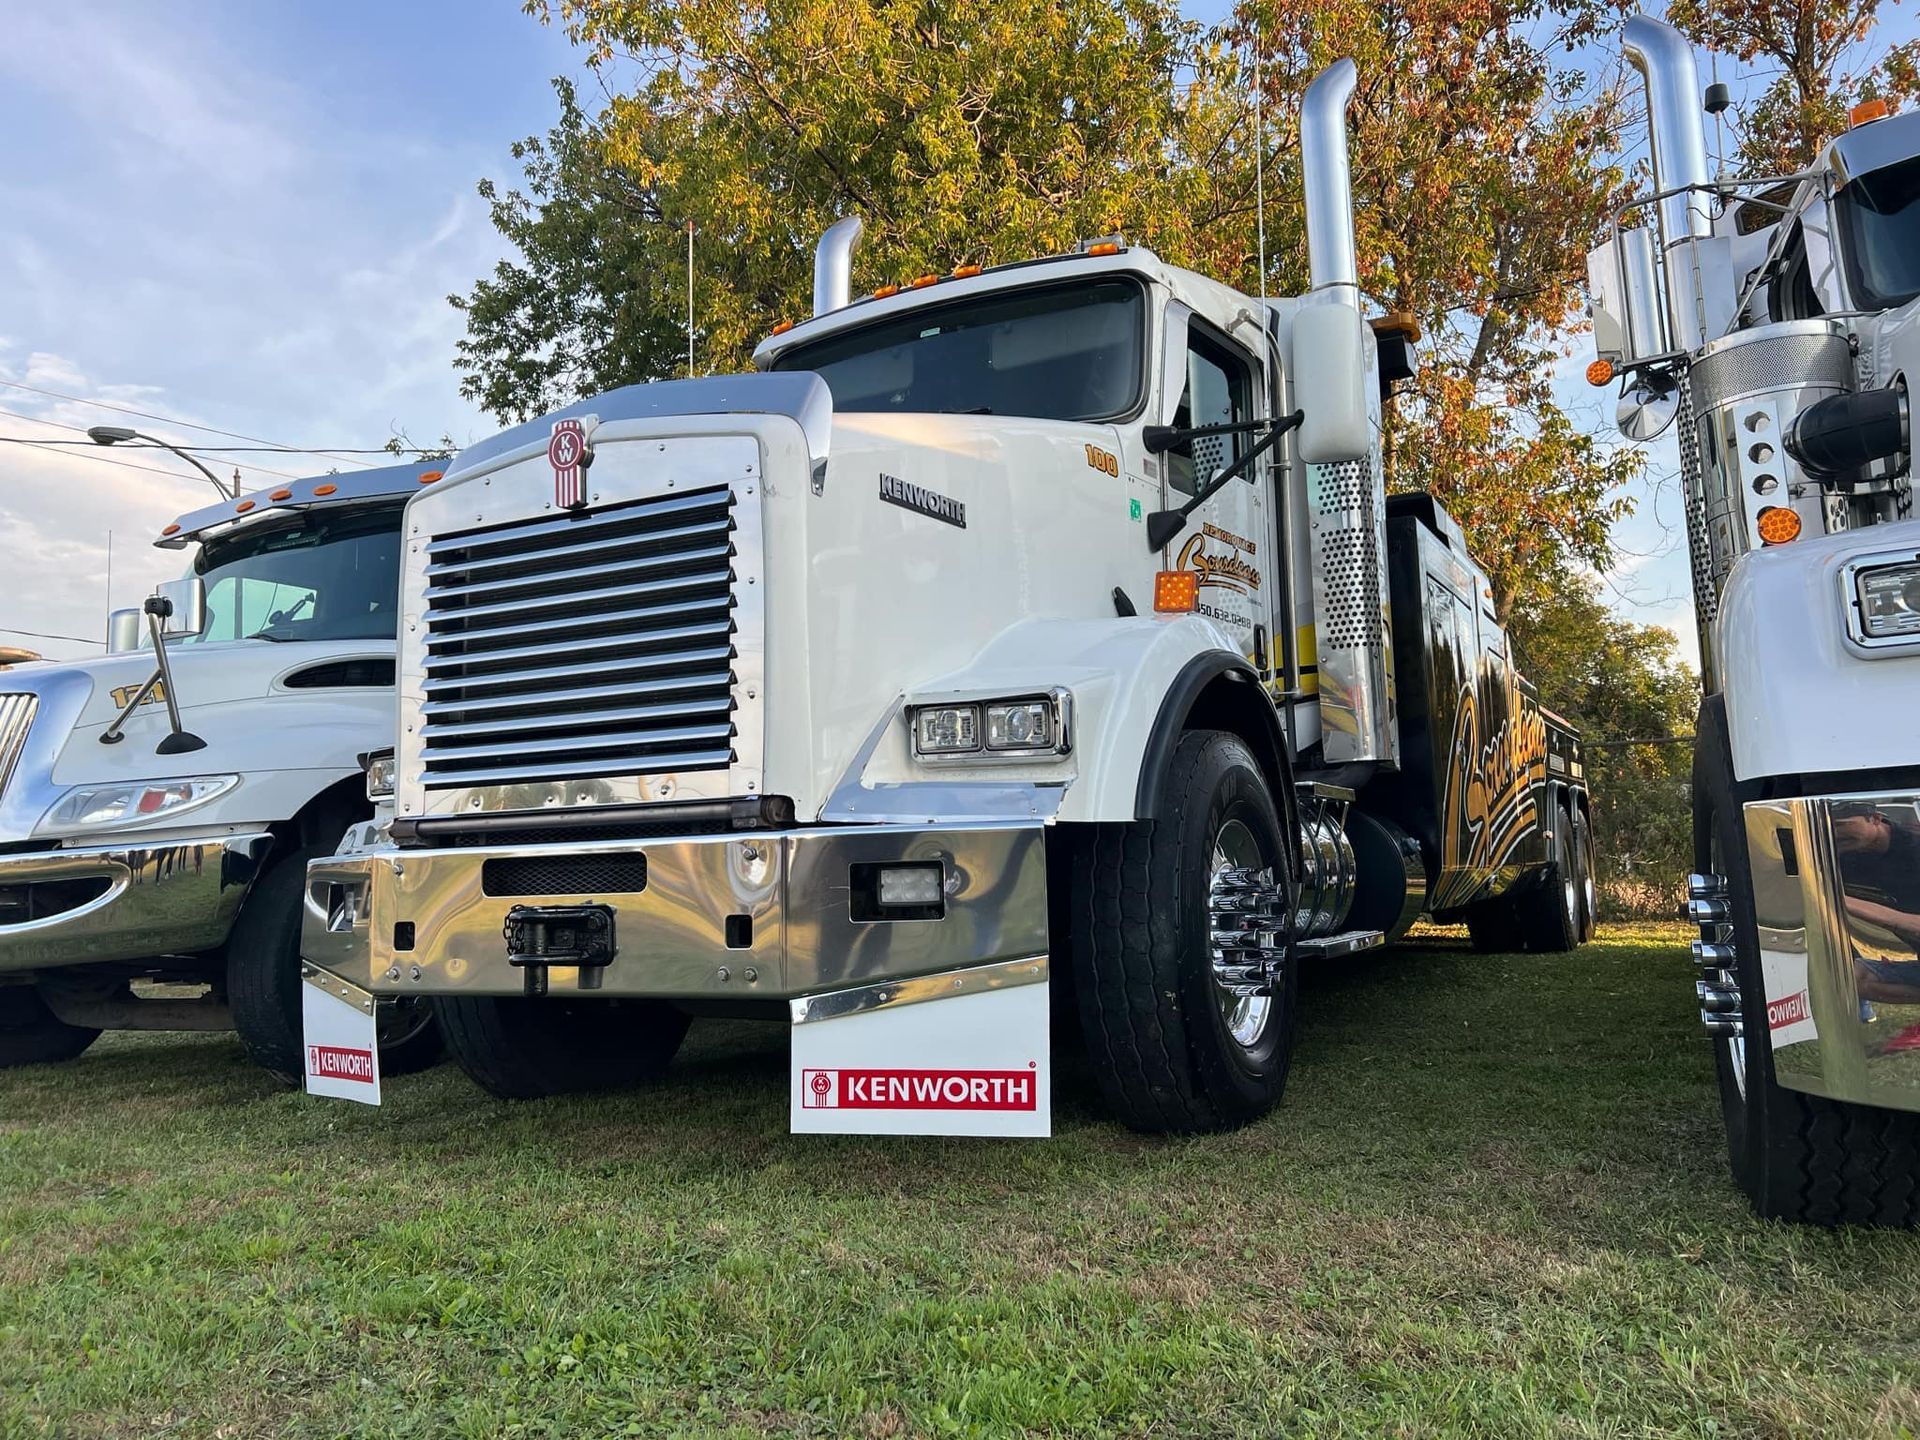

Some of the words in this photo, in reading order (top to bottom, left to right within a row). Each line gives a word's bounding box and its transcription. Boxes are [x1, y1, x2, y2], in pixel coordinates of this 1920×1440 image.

[1085, 443, 1119, 478] 100
[881, 473, 966, 522] KENWORTH
[1203, 522, 1257, 555] REMORQUAGE
[1199, 603, 1251, 629] 50.632.0288
[320, 1051, 372, 1078] KENWORTH
[848, 1077, 1028, 1104] KENWORTH
